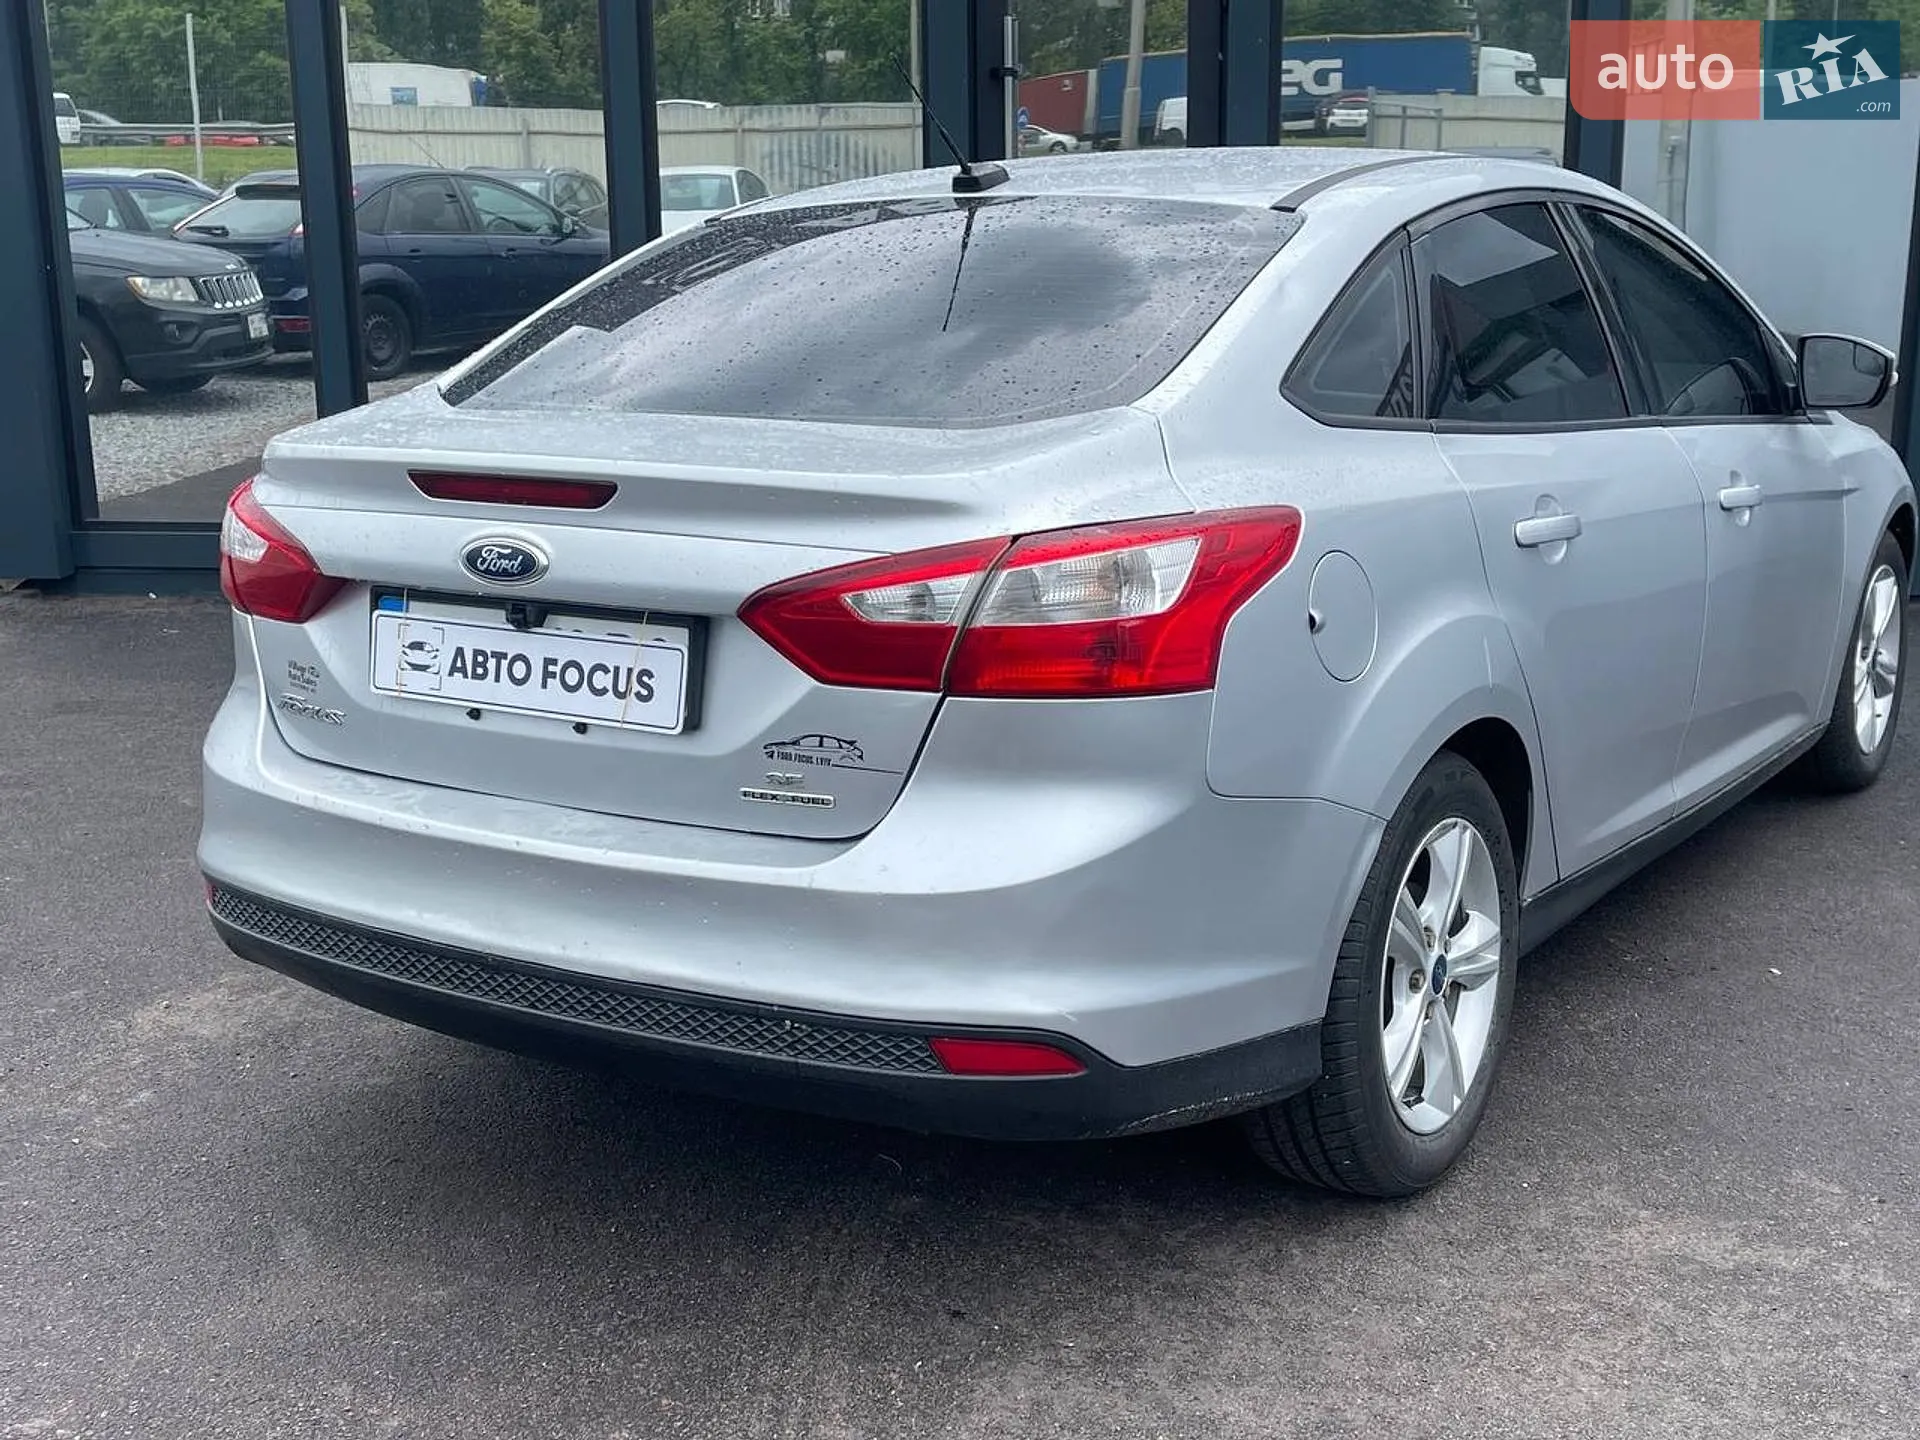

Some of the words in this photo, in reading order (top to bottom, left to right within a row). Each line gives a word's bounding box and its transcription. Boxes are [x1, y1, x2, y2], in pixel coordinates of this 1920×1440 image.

[476, 545, 523, 575] Ford
[541, 657, 656, 703] FOCUS
[742, 791, 779, 802] FLEX
[790, 795, 833, 806] FUEL
